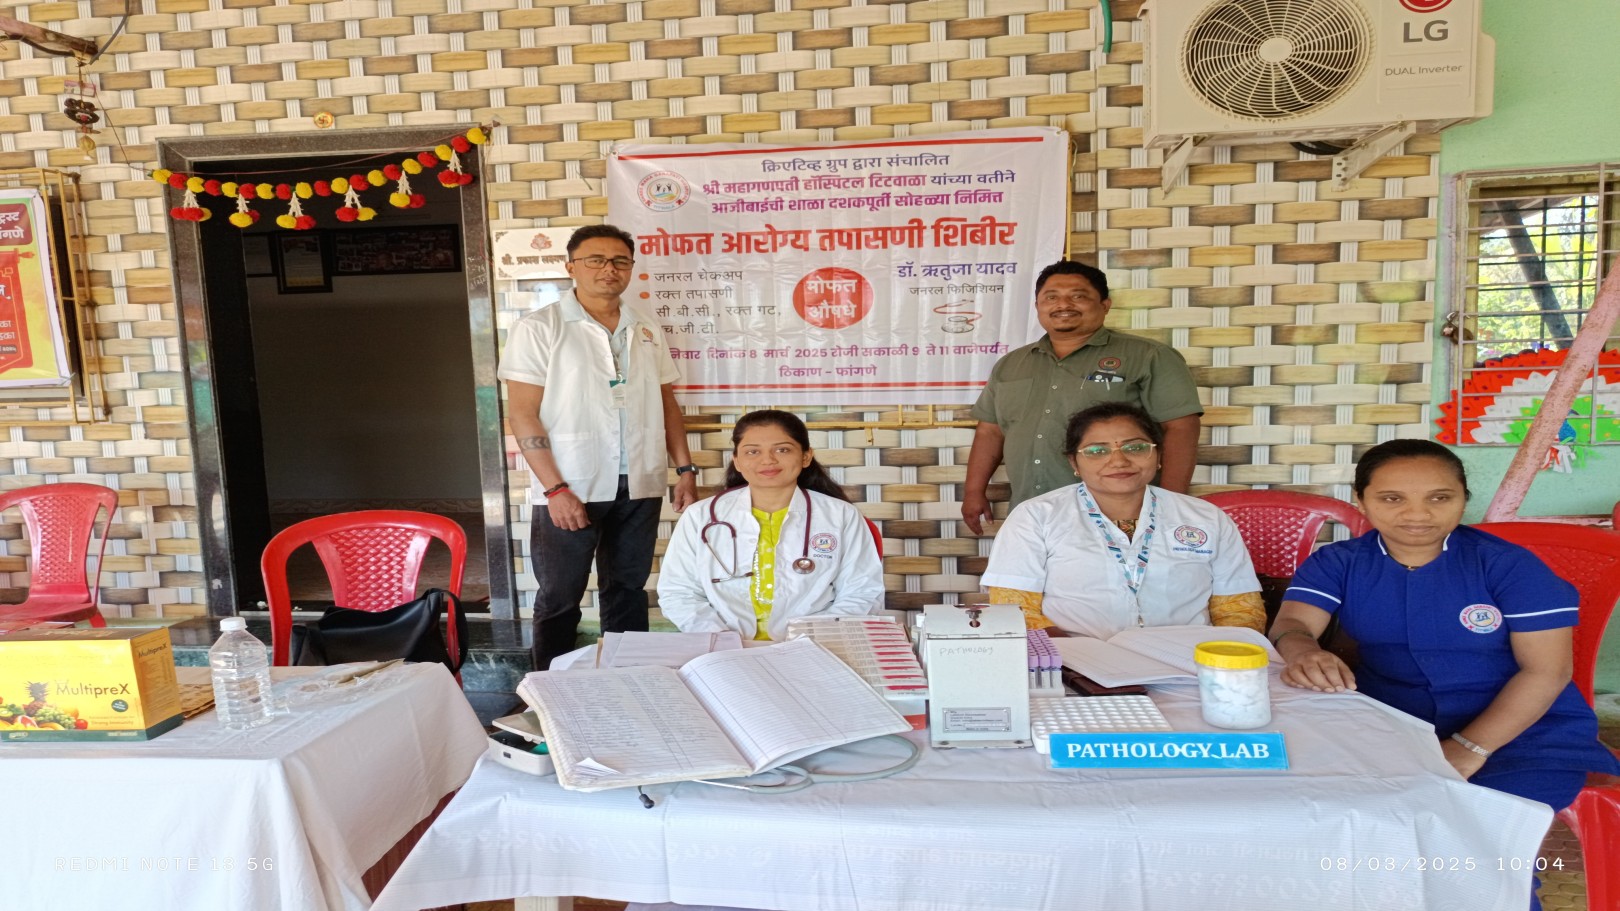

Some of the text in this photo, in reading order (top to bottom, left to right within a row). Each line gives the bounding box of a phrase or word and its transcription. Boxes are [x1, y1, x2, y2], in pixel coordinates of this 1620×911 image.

[1403, 19, 1449, 43] LG
[1385, 64, 1463, 77] DUAL Inverter
[761, 153, 950, 173] क्रिएटिव्ह ग्रुप द्वारा संचालित
[702, 169, 1017, 195] श्री महागणपती हॉस्पिटल टिटवाळा यांच्या वतीने
[711, 188, 1004, 213] आजीबाईची शाळा दशकपूर्ती सोहळ्या निमित्त
[637, 215, 1018, 256] मोफत आरोग्य तपासणी शिबीर
[654, 268, 743, 284] जनरल चेकअप
[897, 261, 1018, 281] डॉ. ऋतुजा यादव
[654, 286, 733, 300] रक्त तपासणी
[806, 275, 857, 295] मोफत
[909, 283, 1004, 296] जनरल फिजिशियन
[725, 305, 752, 316] रक्त
[807, 301, 857, 320] औषधे
[661, 322, 719, 335] च.जी.टी.
[669, 346, 701, 360] निवार
[707, 345, 746, 359] दिनांक
[749, 349, 758, 359] 8
[763, 345, 791, 359] मार्च
[795, 348, 828, 358] 2025
[830, 344, 859, 358] रोजी
[862, 343, 909, 357] सकाळी
[912, 347, 919, 356] 9
[926, 343, 937, 356] ते
[939, 346, 949, 355] 11
[779, 365, 822, 378] ठिकाण
[836, 363, 877, 377] फांगणे
[55, 682, 131, 699] MultipreX
[1067, 743, 1270, 759] PATHOLOGY LAB
